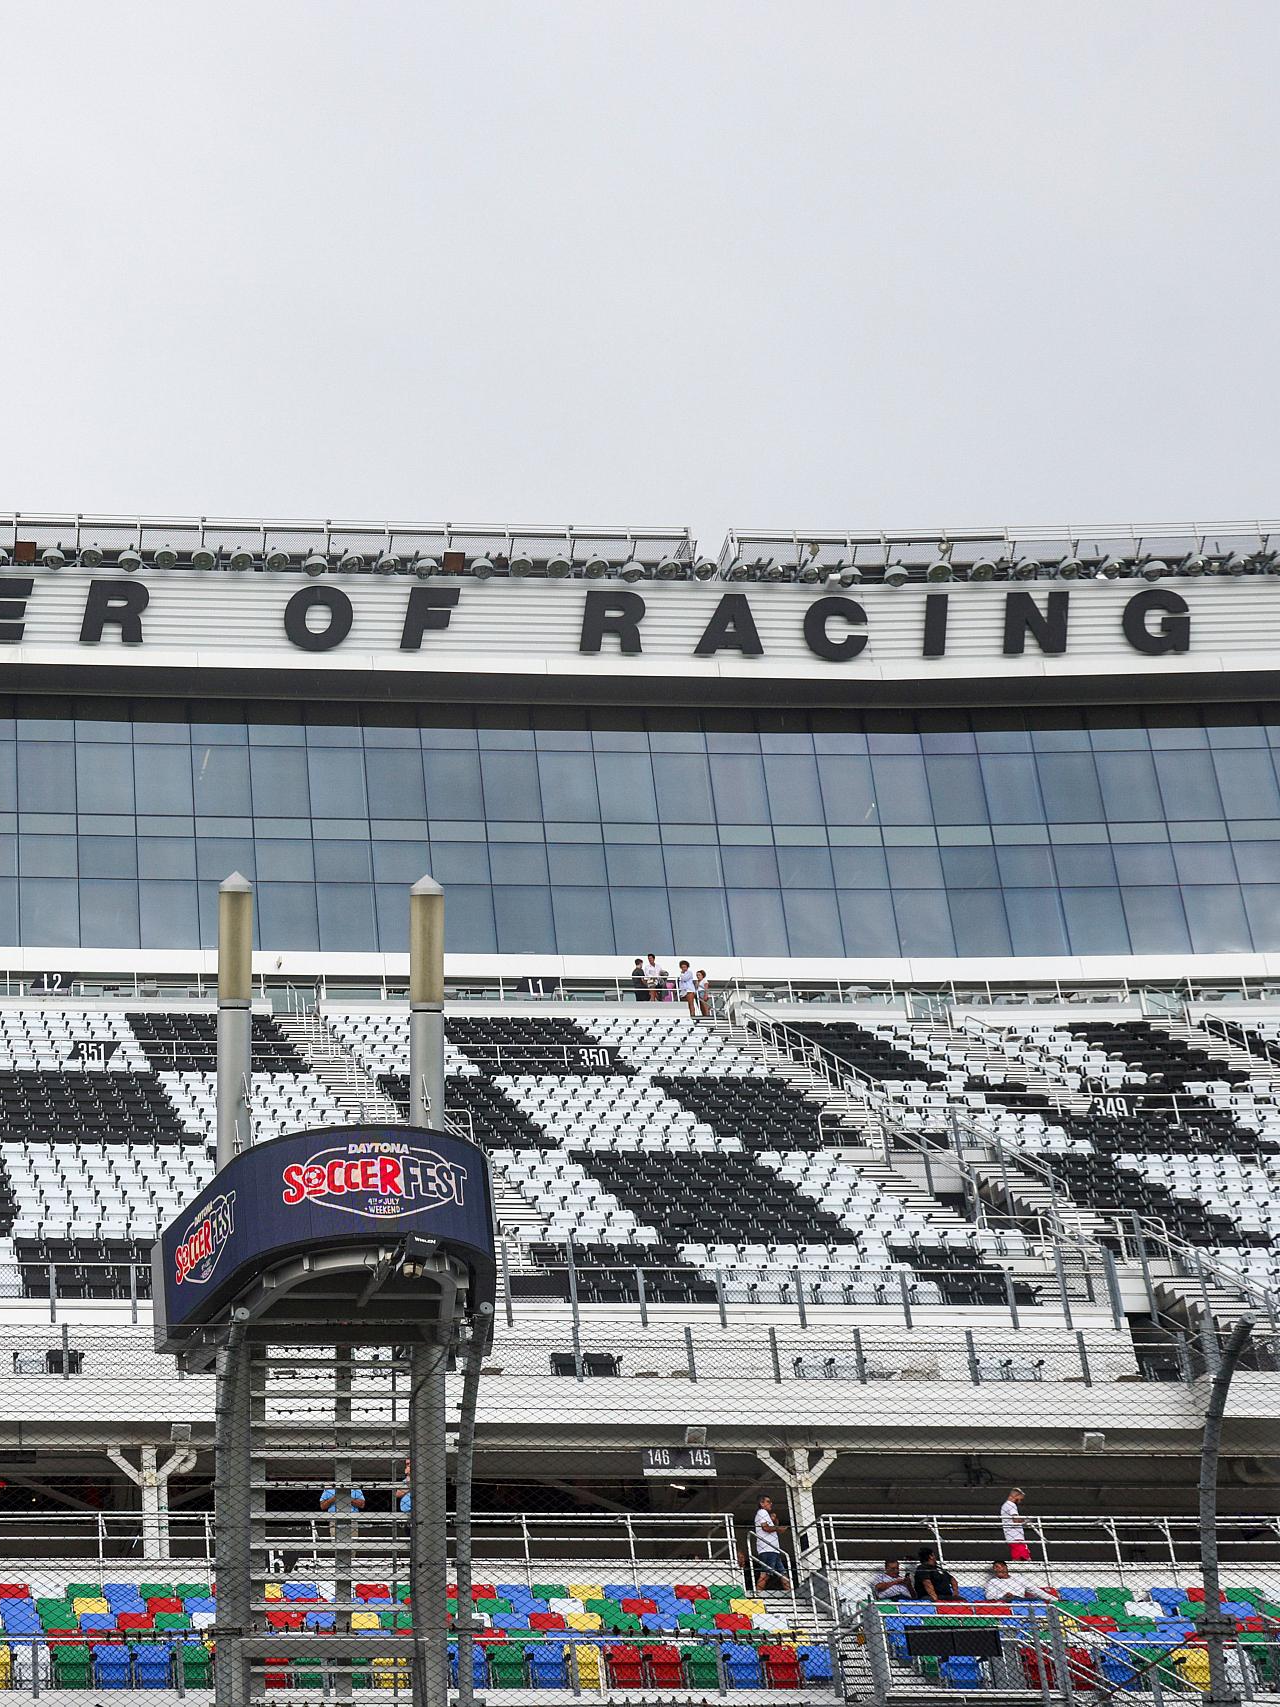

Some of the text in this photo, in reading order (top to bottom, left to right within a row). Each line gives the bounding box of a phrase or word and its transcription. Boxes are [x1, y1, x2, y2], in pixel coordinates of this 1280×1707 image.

[283, 585, 461, 653] OF
[579, 588, 1191, 663] RACING
[43, 973, 62, 992] L2
[528, 979, 545, 996] L1
[78, 1043, 105, 1061] 351
[578, 1048, 610, 1066] 350
[1093, 1097, 1129, 1119] 349
[348, 1143, 410, 1155] DAYTONA
[283, 1156, 468, 1206] SOCCERFEST
[383, 1197, 400, 1205] JULY
[647, 1449, 711, 1466] 146 145
